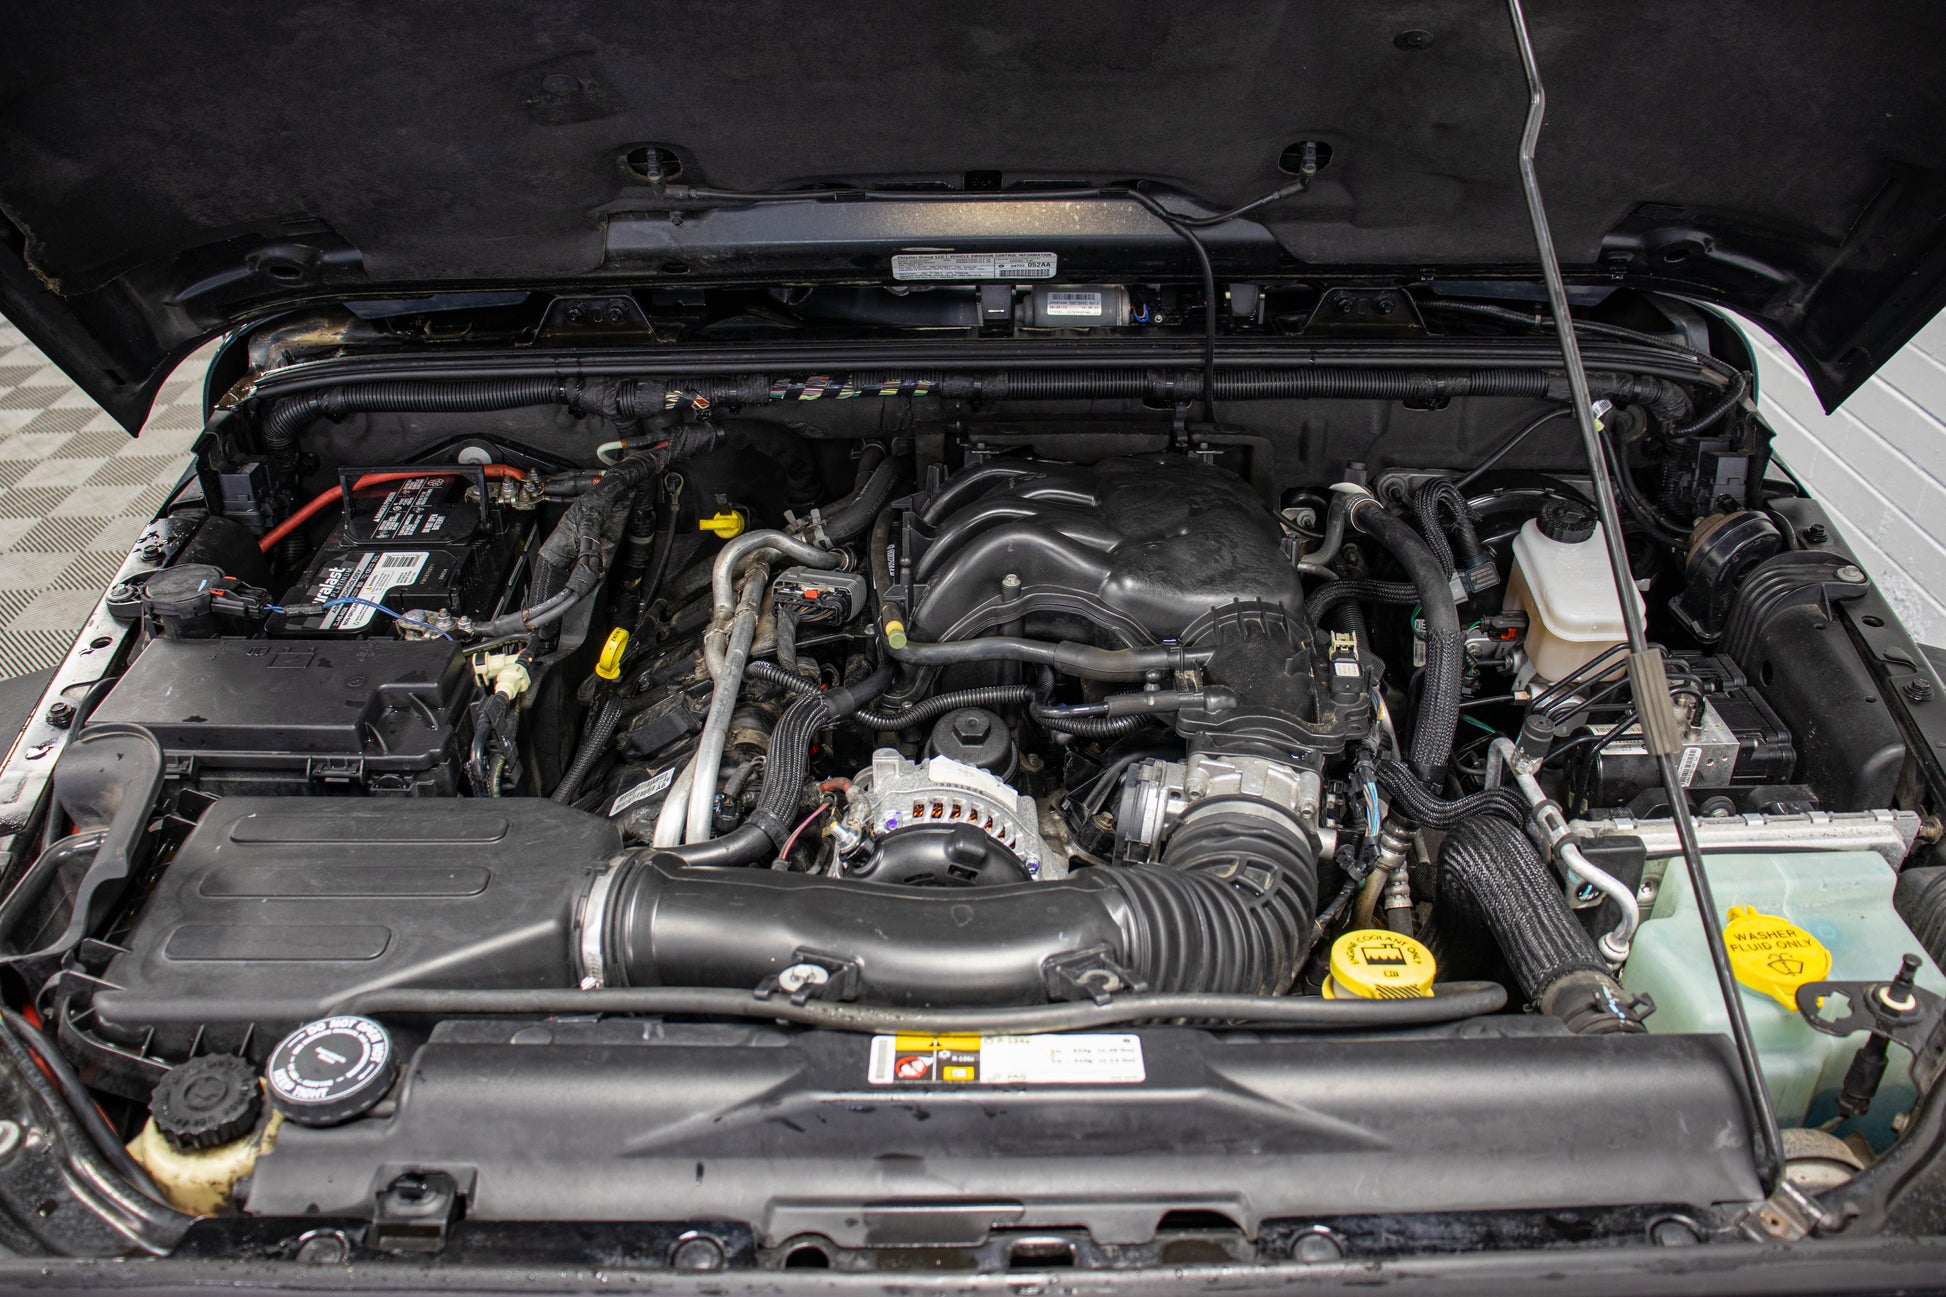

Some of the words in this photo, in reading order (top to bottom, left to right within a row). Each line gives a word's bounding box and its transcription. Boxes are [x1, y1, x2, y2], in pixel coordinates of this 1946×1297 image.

[312, 566, 347, 604] uralast
[1356, 934, 1408, 947] COOLANT
[1733, 929, 1798, 941] WASHER
[1729, 942, 1773, 953] FLUID
[1775, 938, 1813, 949] ONLY
[305, 1022, 327, 1036] DO
[329, 1018, 359, 1029] NOT
[355, 1021, 383, 1043] OPEN
[291, 1085, 330, 1099] TIGHT
